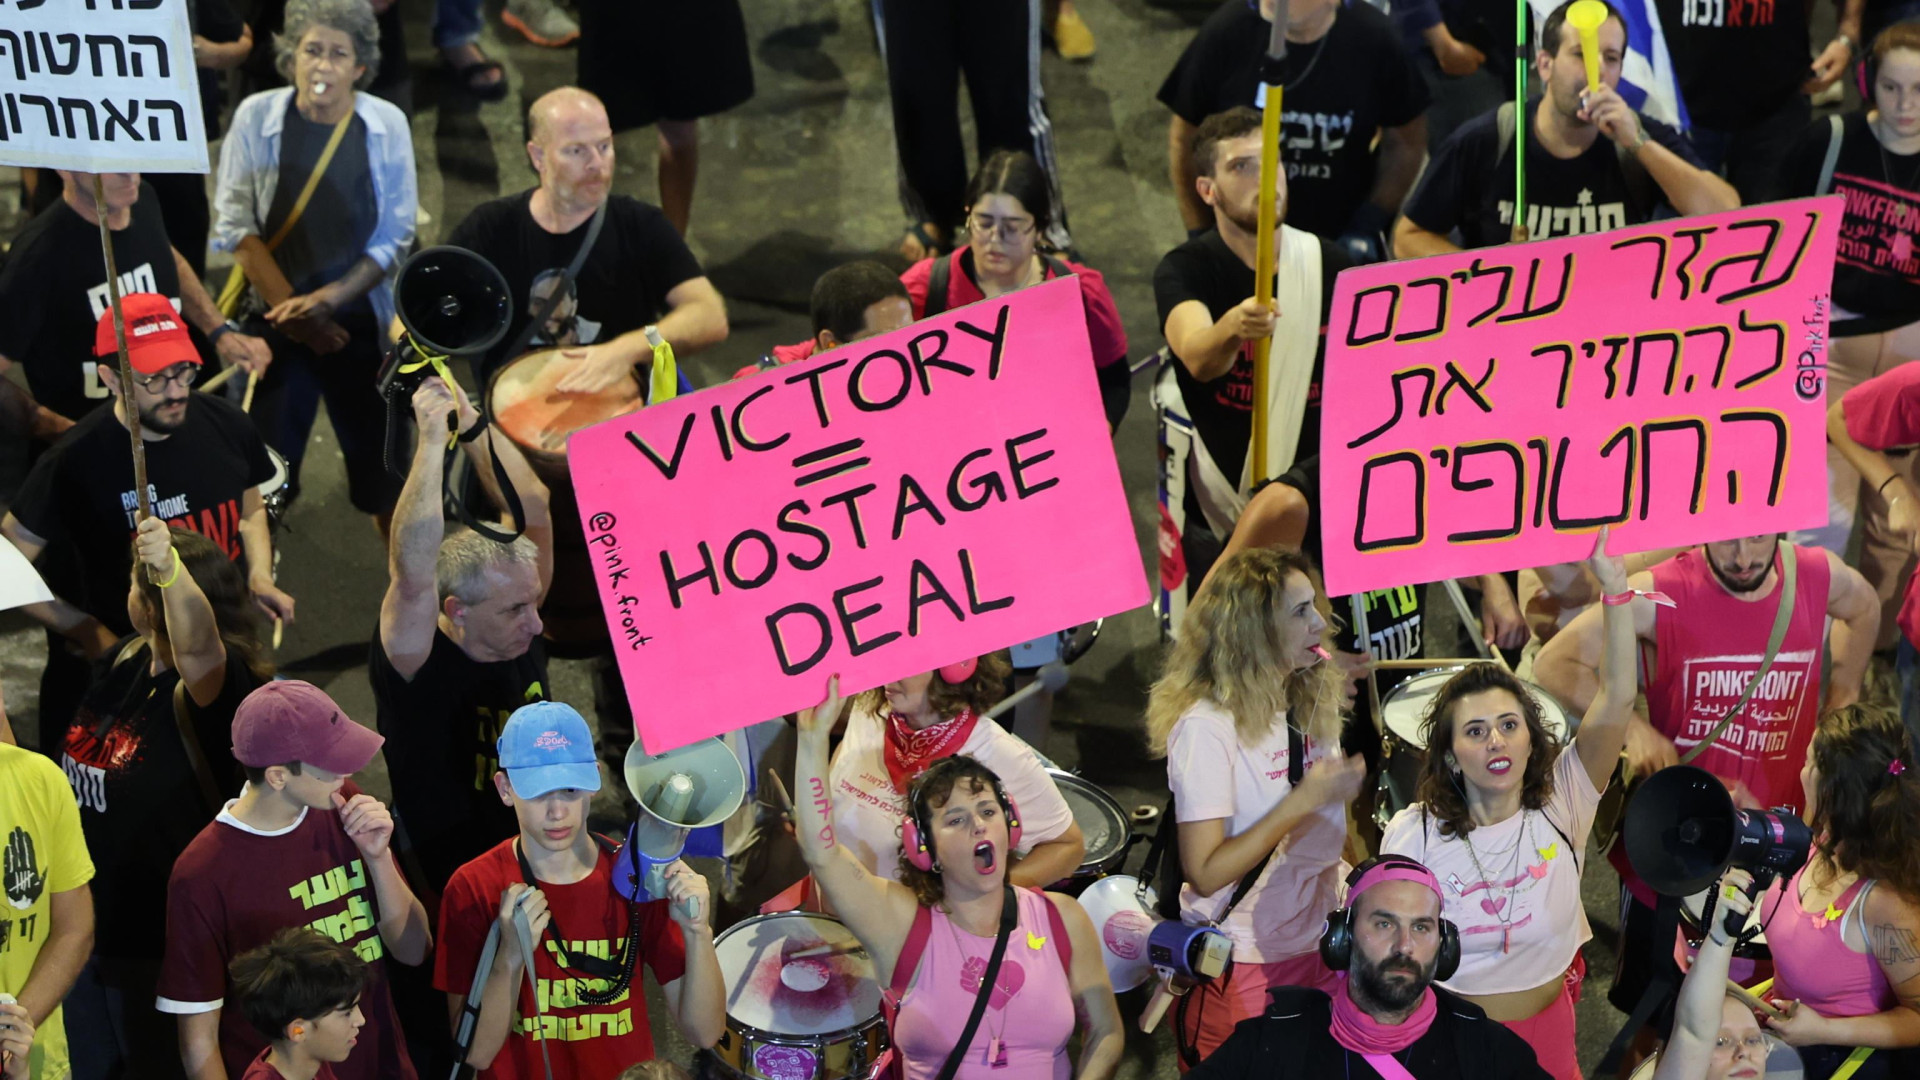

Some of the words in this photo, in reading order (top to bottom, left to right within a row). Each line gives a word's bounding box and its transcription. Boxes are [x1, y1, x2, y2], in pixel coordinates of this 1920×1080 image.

[0, 29, 170, 81] החטוף
[1835, 185, 1920, 234] INKFRON
[1346, 253, 1576, 347] עליכם
[1611, 211, 1822, 303] נגזר
[624, 305, 1010, 480] VICTORY
[1347, 358, 1496, 448] את
[1531, 309, 1788, 409] להחזיר
[121, 484, 158, 511] BRG
[156, 493, 190, 519] HOME
[659, 428, 1060, 609] HOSTAGE
[1354, 407, 1791, 553] החטופים
[588, 511, 654, 651] @pink.front
[765, 548, 1015, 676] DEAL
[1695, 670, 1803, 701] PINKFRONT
[289, 859, 367, 911] נוער
[303, 895, 375, 944] למ
